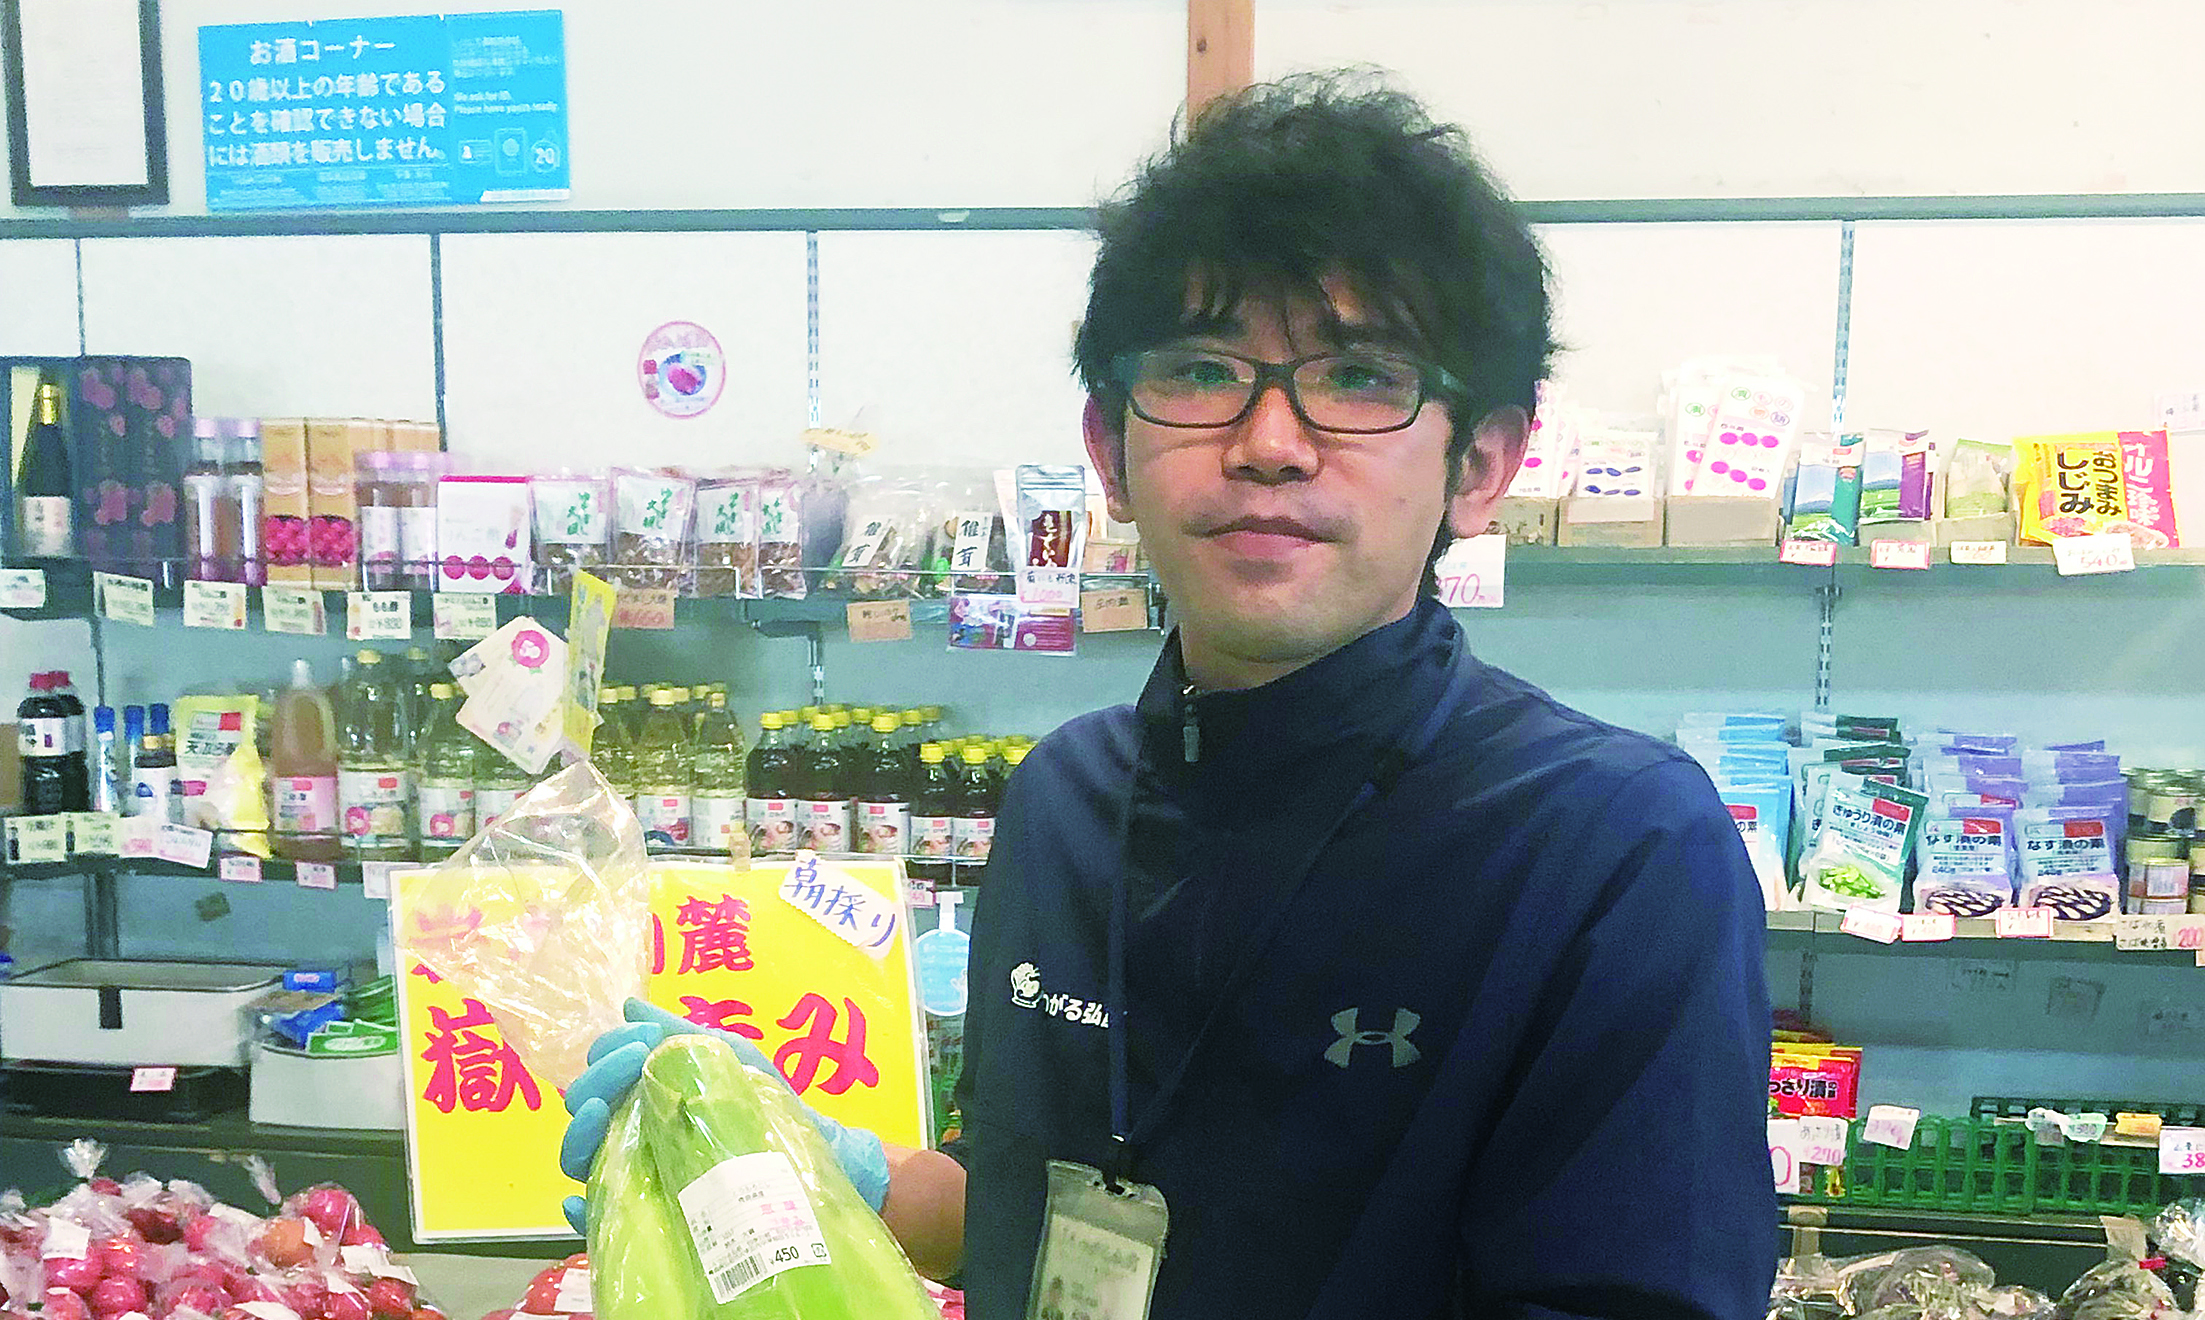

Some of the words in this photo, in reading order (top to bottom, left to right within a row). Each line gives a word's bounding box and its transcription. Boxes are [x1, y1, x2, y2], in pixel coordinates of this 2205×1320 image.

[250, 35, 396, 64] お酒コーナー
[209, 102, 446, 135] ことを確認できない場合
[209, 136, 447, 166] には酒類を販売しません。
[2056, 451, 2095, 515] しじみ
[2092, 450, 2122, 516] おつまみ
[1832, 804, 1907, 836] きゅうり漬の素
[1925, 834, 2002, 847] なす漬の素
[2027, 838, 2106, 851] なす漬の素
[783, 857, 898, 950] 朝採り
